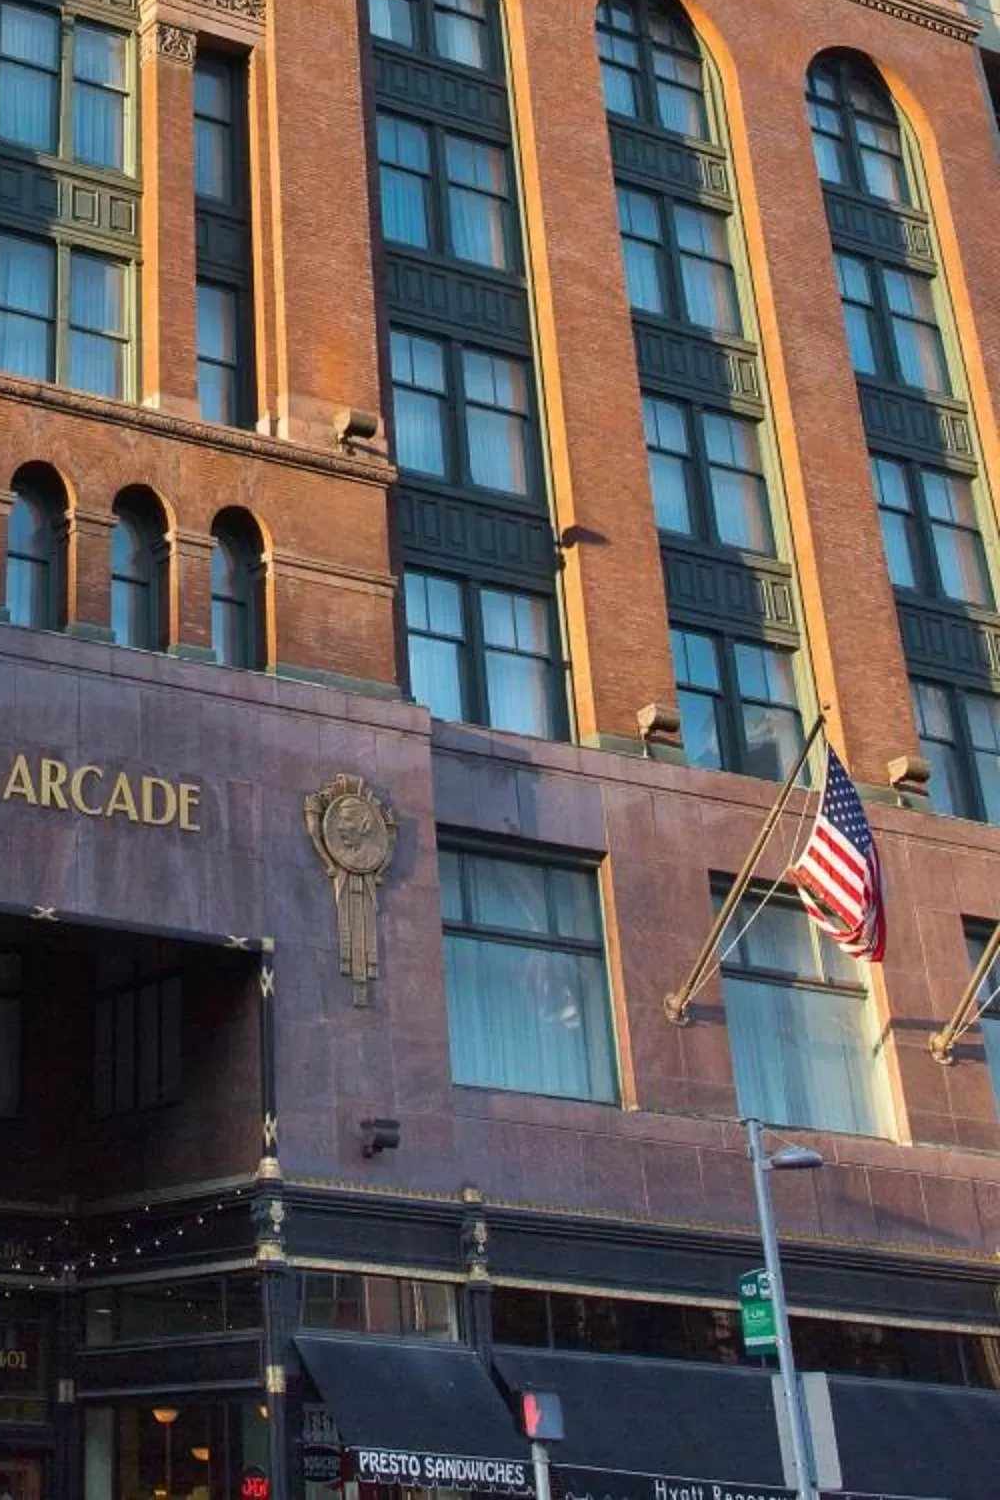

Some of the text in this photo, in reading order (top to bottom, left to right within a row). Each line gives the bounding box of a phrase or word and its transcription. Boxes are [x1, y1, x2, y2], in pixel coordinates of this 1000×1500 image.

[2, 753, 201, 832] ARCADE
[359, 1451, 421, 1477] PRESTO
[424, 1457, 526, 1485] SANDWICHES
